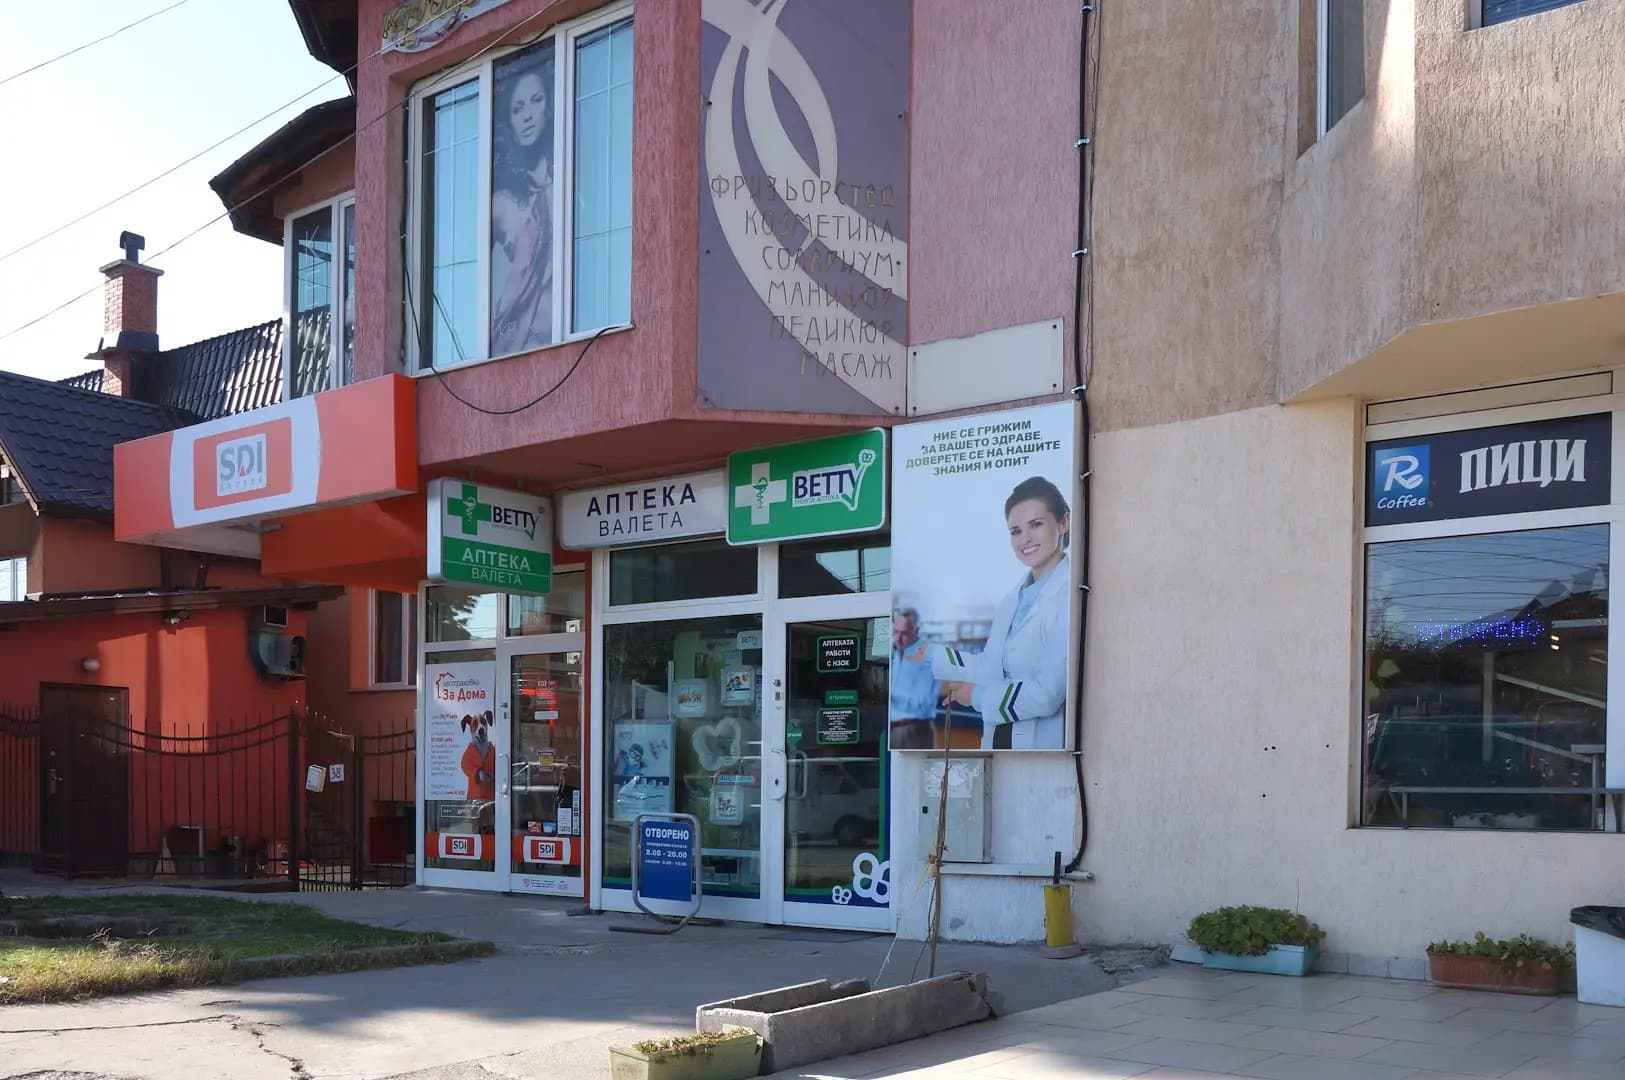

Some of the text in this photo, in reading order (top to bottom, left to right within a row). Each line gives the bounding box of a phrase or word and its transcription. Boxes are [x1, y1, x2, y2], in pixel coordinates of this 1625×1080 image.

[745, 208, 894, 243] КОЗМЕТИКА
[769, 315, 892, 346] ПЕДИКЮР
[933, 420, 1032, 442] НИЕ СЕ ГРИЖИМ
[905, 440, 1061, 469] ДОВЕРЕТЕ СЕ НА НАШИТЕ
[922, 445, 937, 455] ЗА
[939, 438, 990, 453] ВАШЕТО
[220, 440, 263, 481] SDI
[933, 456, 1030, 476] ЗНАНИЯ И ОПИТ
[1459, 438, 1588, 494] ПИЦИ
[1381, 455, 1421, 491] R
[794, 465, 866, 507] BETTY
[586, 483, 697, 517] АПТЕКА
[1377, 494, 1426, 509] Coffee
[493, 506, 539, 541] BETTY
[599, 511, 683, 537] ВАЛЕТА
[462, 547, 531, 572] АПТЕКА
[471, 567, 523, 586] ВАЛЕТА
[822, 639, 854, 647] АПТЕКАТА
[443, 688, 486, 702] За Дома
[332, 767, 342, 779] 38
[453, 840, 467, 850] SDI
[645, 827, 690, 840] ОТВОРЕНО
[539, 844, 554, 854] SDI
